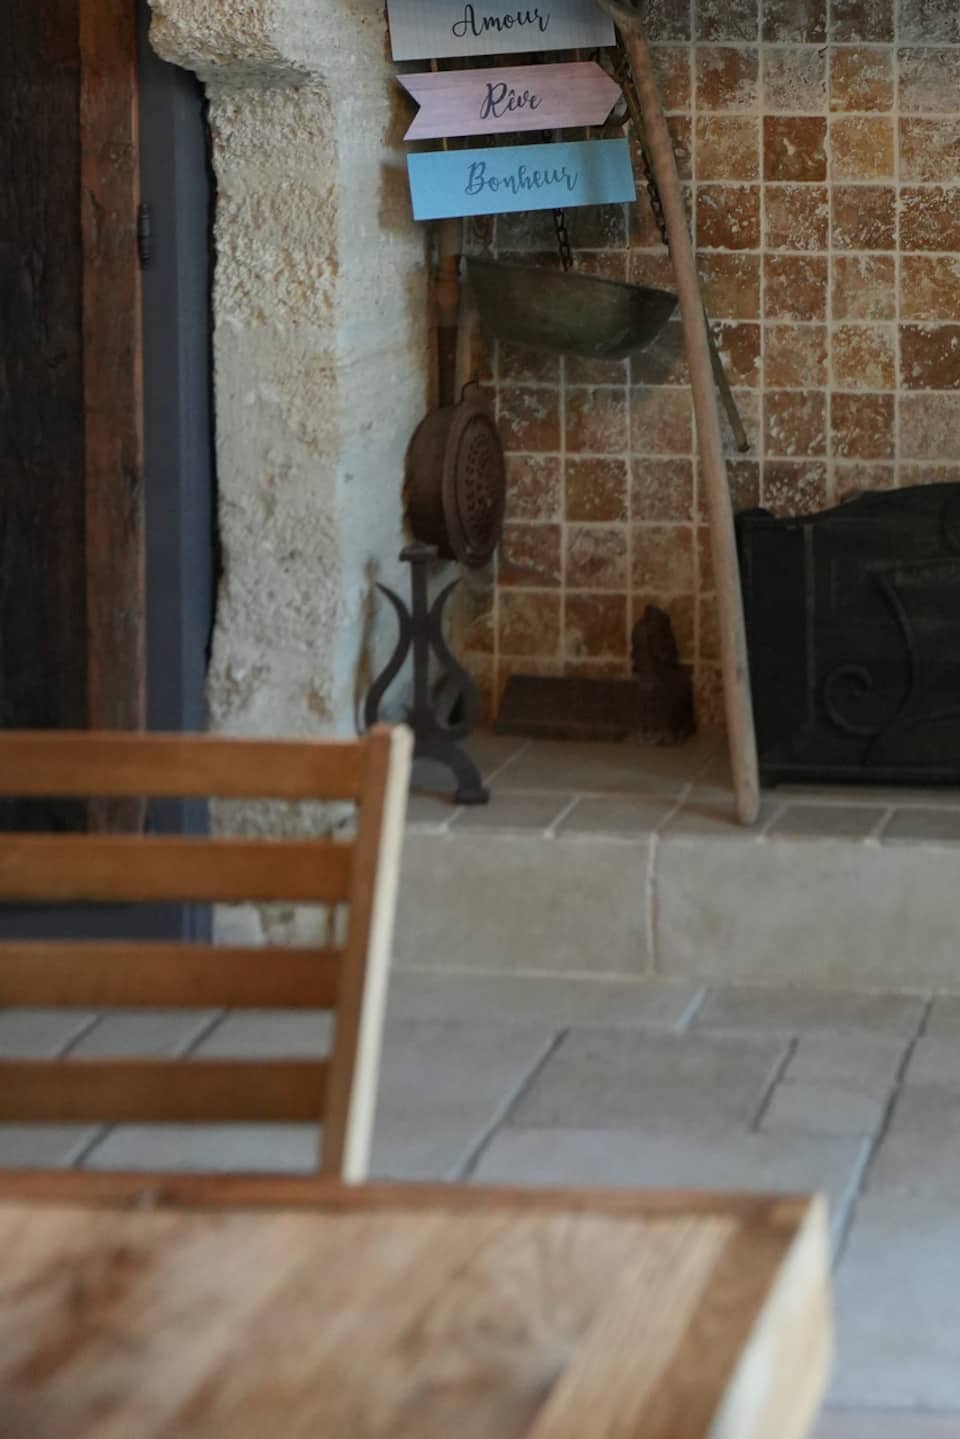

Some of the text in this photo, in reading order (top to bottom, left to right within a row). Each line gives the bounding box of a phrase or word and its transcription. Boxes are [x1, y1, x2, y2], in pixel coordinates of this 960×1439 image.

[451, 3, 550, 38] Amour
[479, 82, 543, 120] Rêve
[464, 161, 579, 196] Bonheur
